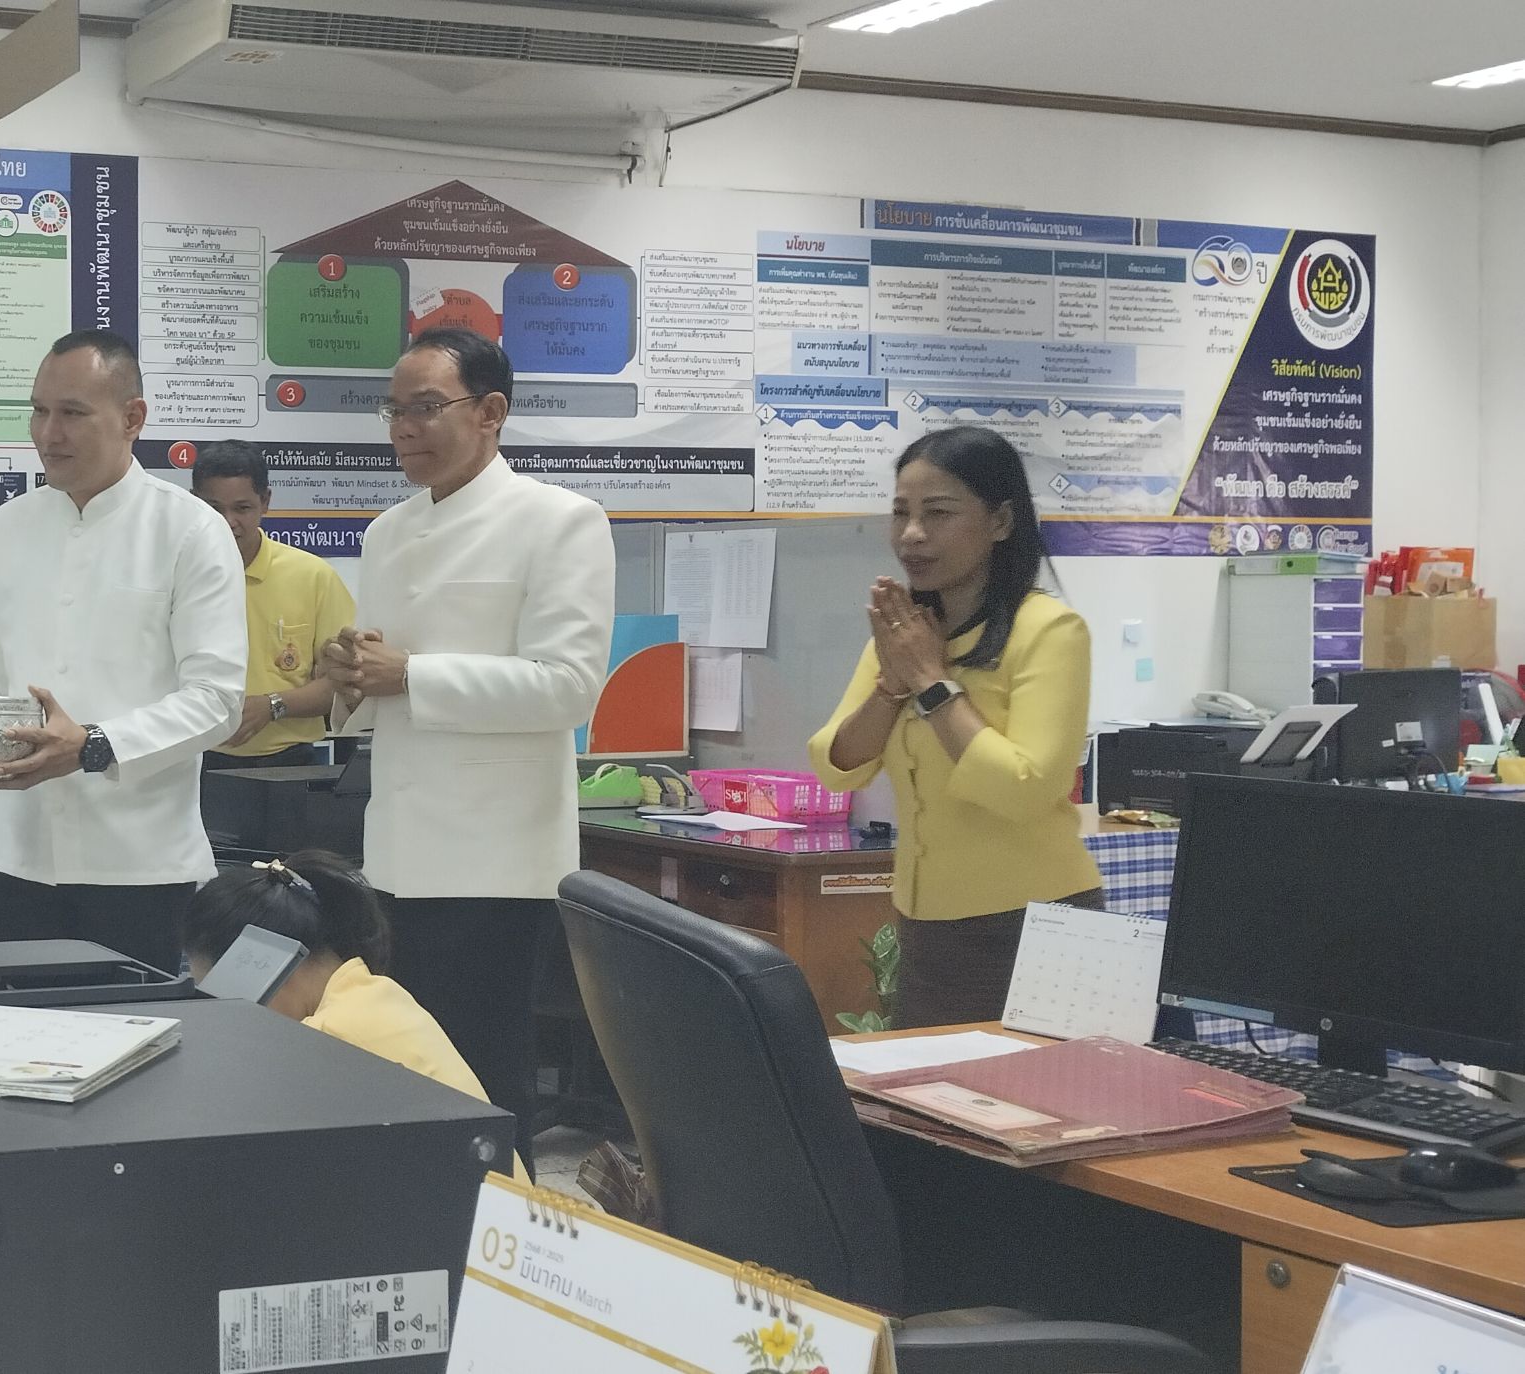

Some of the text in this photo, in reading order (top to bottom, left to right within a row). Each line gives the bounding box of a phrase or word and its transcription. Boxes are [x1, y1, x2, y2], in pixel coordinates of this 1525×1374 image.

[328, 262, 336, 277] 1
[562, 271, 572, 286] 2
[308, 285, 361, 300] เสริมสร้าง
[299, 309, 369, 326] ความเข้มแข็ง
[308, 337, 361, 354] ของชุมชน
[1319, 364, 1362, 380] (Vision)
[286, 387, 296, 402] 3
[910, 395, 917, 407] 2
[763, 407, 769, 419] 1
[1055, 402, 1062, 414] 3
[178, 449, 188, 463] 4
[36, 475, 45, 484] 17
[357, 479, 388, 489] Mindset
[391, 480, 397, 489] &
[1055, 478, 1063, 490] 4
[1133, 928, 1140, 938] 2
[482, 1226, 518, 1271] 03
[520, 1256, 613, 1315] มีนาคม March
